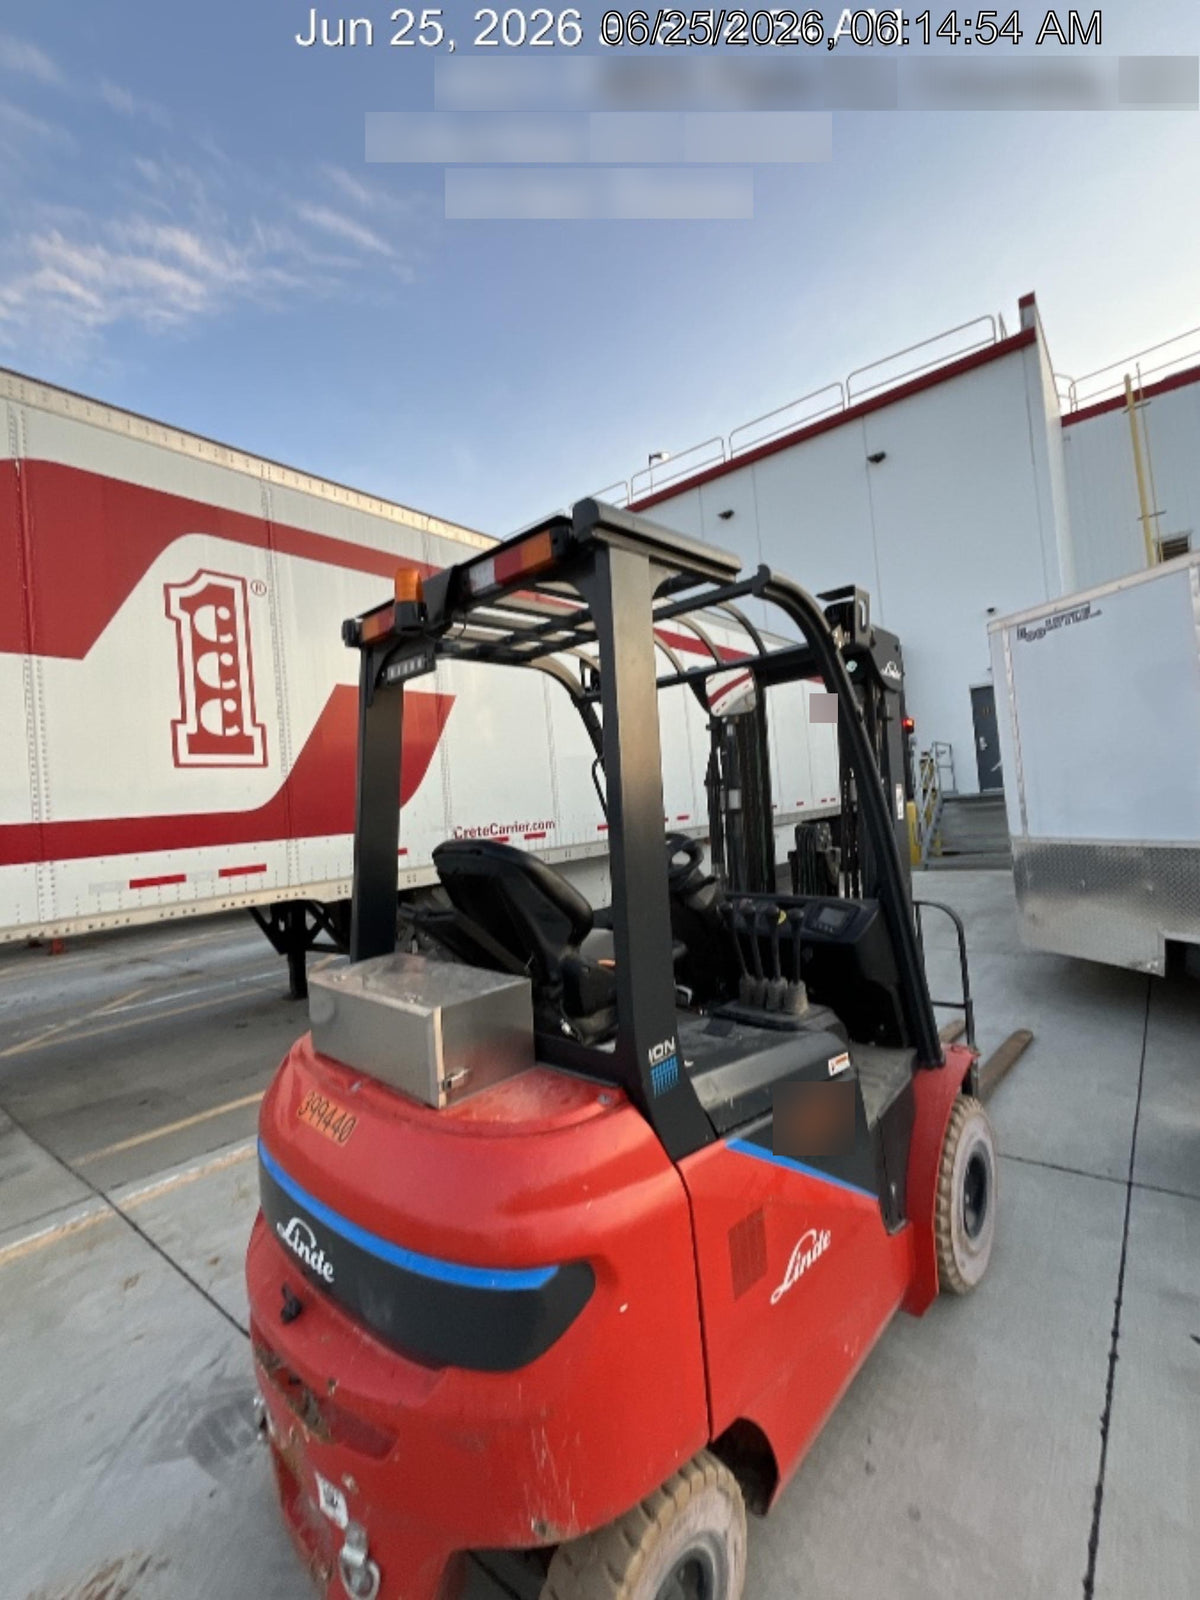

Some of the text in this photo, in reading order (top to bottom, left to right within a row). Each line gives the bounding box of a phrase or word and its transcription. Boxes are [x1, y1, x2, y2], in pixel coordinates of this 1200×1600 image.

[453, 820, 556, 840] CreteCarrier.com
[648, 1036, 675, 1065] ION
[276, 1216, 335, 1283] Linde
[770, 1228, 831, 1306] Linde
